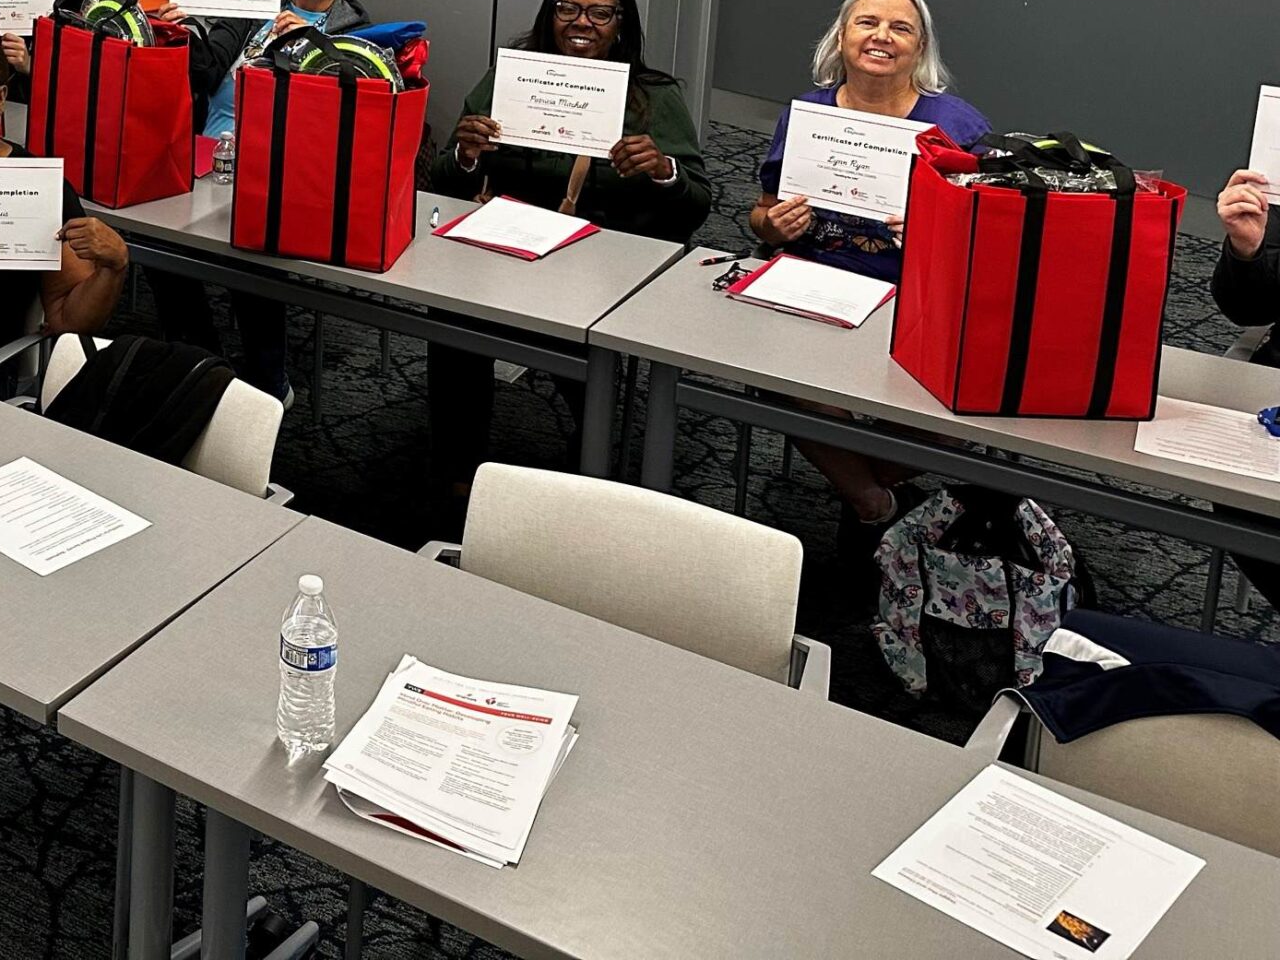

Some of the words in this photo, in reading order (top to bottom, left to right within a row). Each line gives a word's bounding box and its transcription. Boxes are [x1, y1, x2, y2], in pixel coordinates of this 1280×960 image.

[517, 76, 554, 86] Certificate
[564, 82, 606, 93] Completion
[812, 133, 852, 146] Certificate
[863, 142, 908, 156] Completion
[850, 159, 871, 171] Ryan
